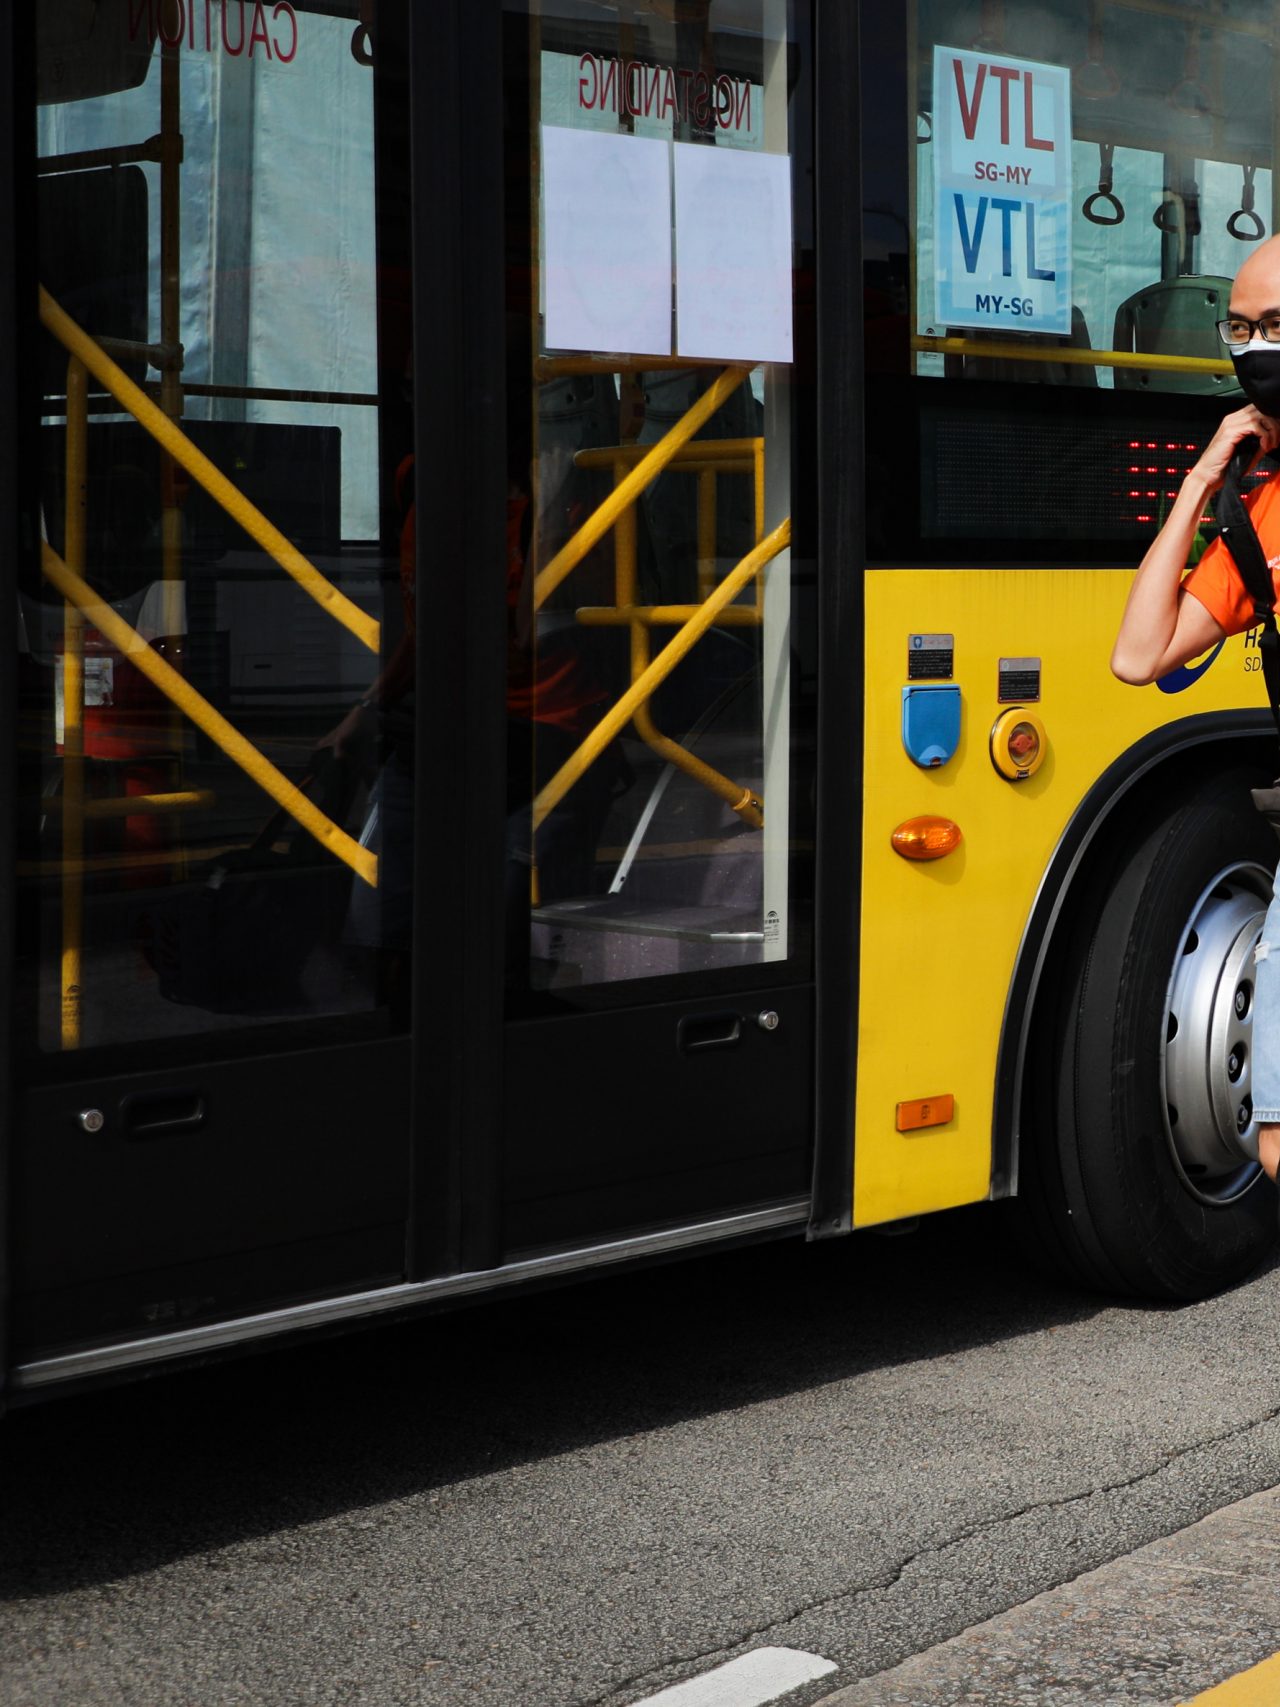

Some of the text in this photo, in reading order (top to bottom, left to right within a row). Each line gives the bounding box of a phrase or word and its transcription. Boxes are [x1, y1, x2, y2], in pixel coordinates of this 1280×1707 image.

[952, 58, 1055, 152] VTL
[975, 160, 1032, 186] SG-MY
[953, 192, 1056, 282] VTL
[975, 293, 1034, 317] MY-SG
